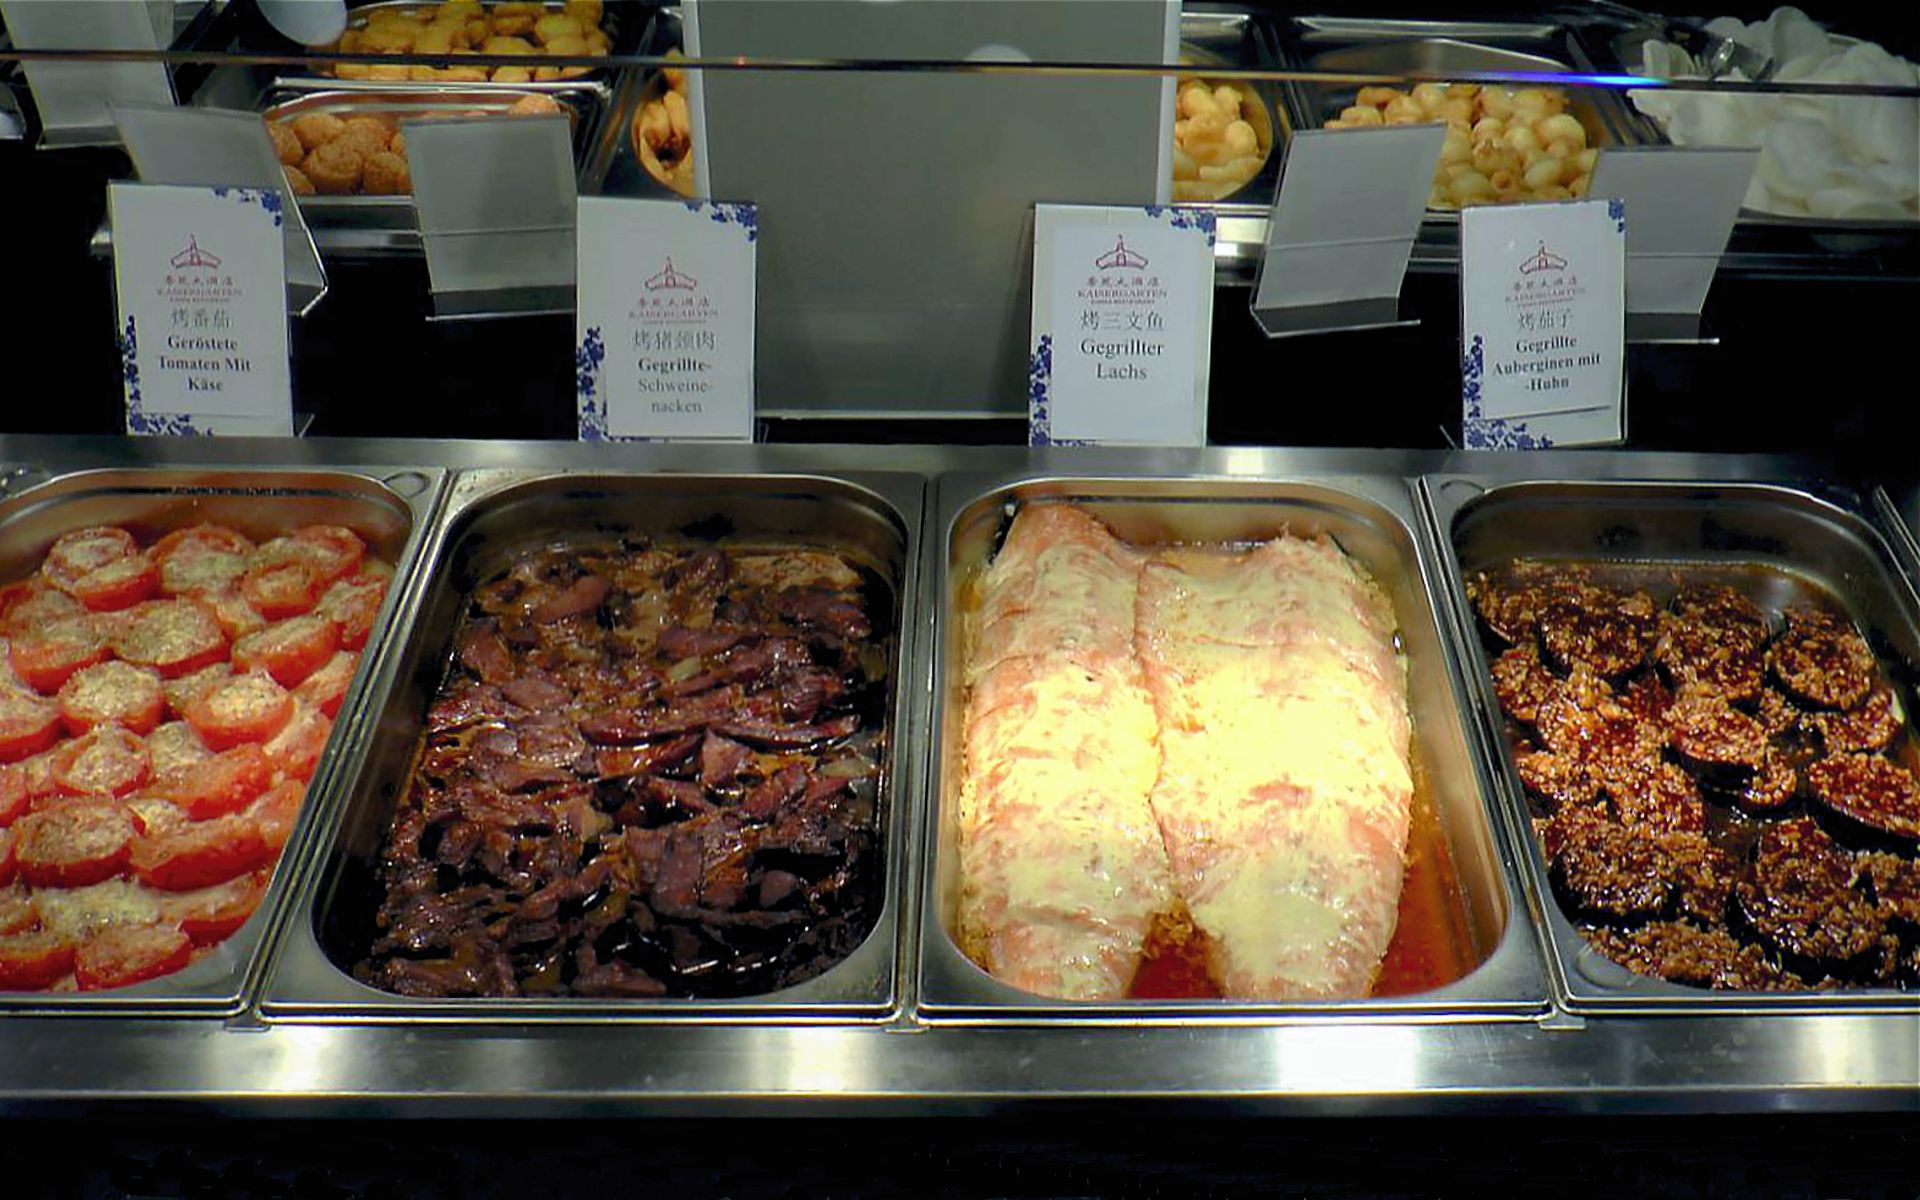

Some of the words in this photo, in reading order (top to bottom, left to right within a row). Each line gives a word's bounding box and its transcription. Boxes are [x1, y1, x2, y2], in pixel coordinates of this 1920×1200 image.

[1077, 288, 1167, 299] KAISERGARTEN
[1080, 308, 1165, 331] 烤三文鱼
[167, 336, 237, 351] Geröstete
[1080, 338, 1164, 359] Gegrillter
[1516, 336, 1578, 354] Gegrillte
[158, 355, 220, 370] Tomaten
[225, 357, 251, 372] Mit
[638, 357, 712, 374] Gegrillte-
[1096, 362, 1148, 379] Lachs
[1492, 357, 1574, 376] Auberginen
[1578, 352, 1600, 368] mit
[187, 376, 223, 391] Käse
[637, 378, 713, 393] Schweine-
[1524, 375, 1569, 392] -Huhn
[651, 398, 702, 413] nacken
